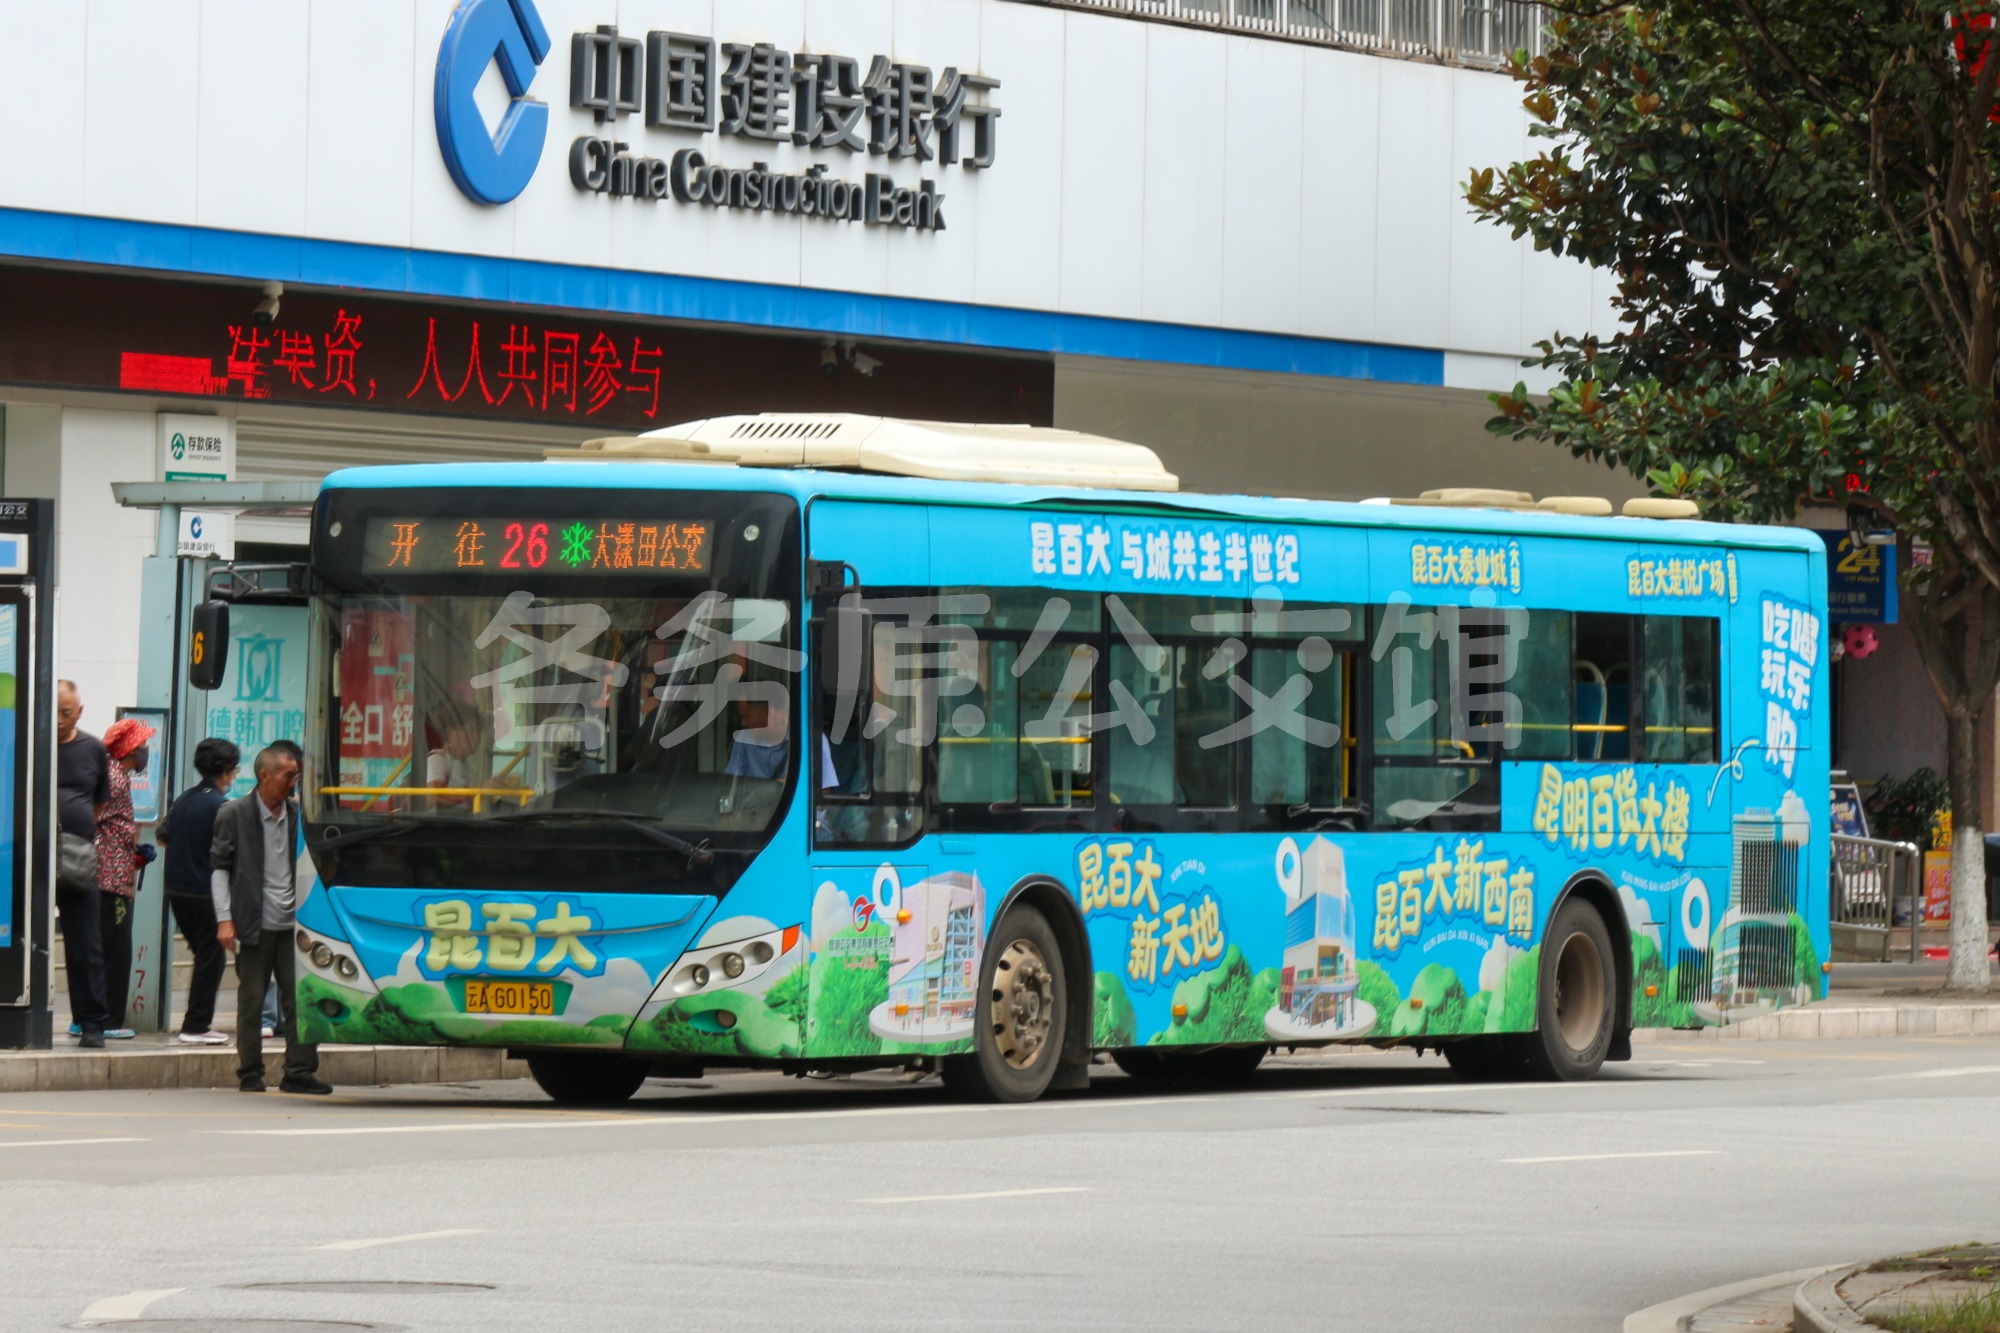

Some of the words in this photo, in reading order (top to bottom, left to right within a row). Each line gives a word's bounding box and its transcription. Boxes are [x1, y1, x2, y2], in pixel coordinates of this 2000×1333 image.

[570, 24, 1002, 169] 中国建设银行
[568, 135, 669, 200] China
[670, 147, 864, 222] Construction
[864, 172, 947, 231] Bank
[187, 436, 222, 453] 存款保险
[0, 505, 28, 516] 公交
[500, 522, 549, 568] 26
[1030, 522, 1111, 576] 昆百大
[1121, 528, 1300, 583] 与城共生半世纪
[1411, 544, 1508, 587] 昆百大泰业城
[1836, 537, 1881, 573] 24
[1627, 557, 1726, 597] 昆百大楚悦广场
[1761, 599, 1820, 667] 吃喝
[1760, 648, 1811, 711] 玩乐
[208, 706, 305, 748] 德韩口腔
[1765, 700, 1798, 780] 购
[1533, 762, 1690, 863] 昆明百货大楼
[1079, 842, 1162, 914] 昆百大
[1181, 858, 1198, 873] TIAN
[1373, 837, 1535, 951] 昆百大新西南
[424, 899, 598, 972] 昆百大
[1127, 894, 1225, 984] 新天地
